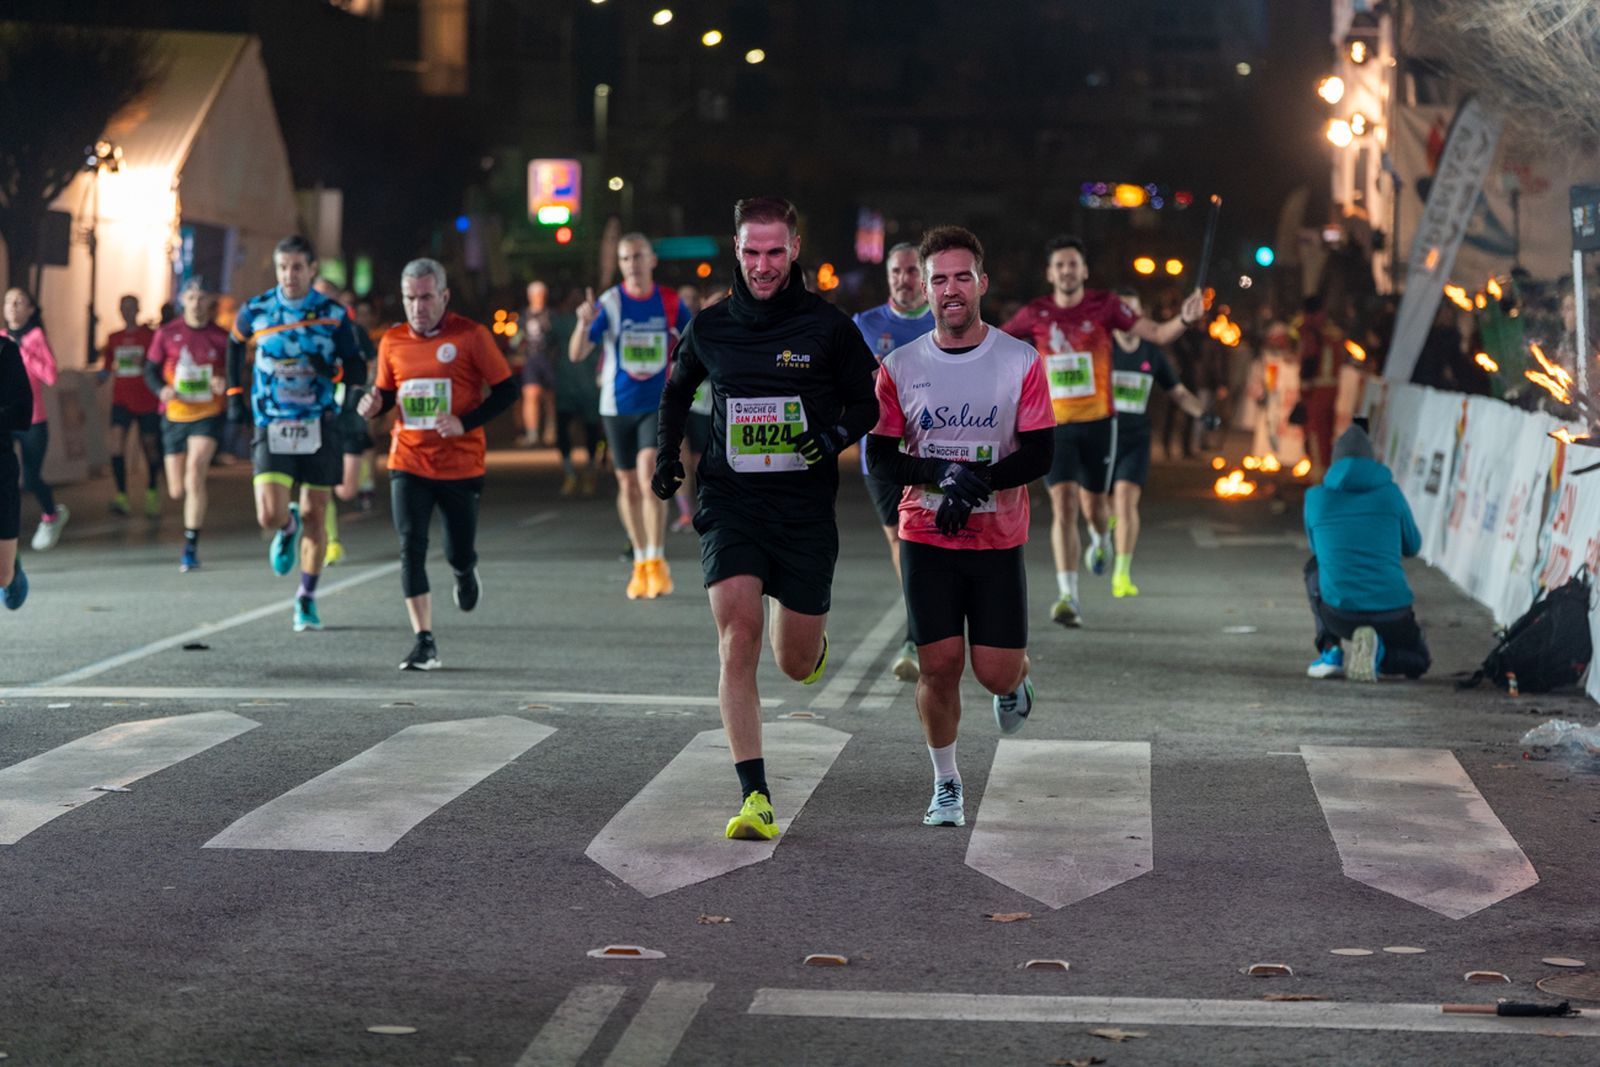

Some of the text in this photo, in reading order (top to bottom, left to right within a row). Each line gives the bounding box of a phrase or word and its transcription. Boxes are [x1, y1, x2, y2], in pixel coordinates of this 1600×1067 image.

[768, 404, 777, 413] DE
[752, 412, 778, 422] ANTÓN
[933, 402, 998, 429] Salud
[743, 424, 791, 446] 8424
[936, 448, 959, 457] NOCHE
